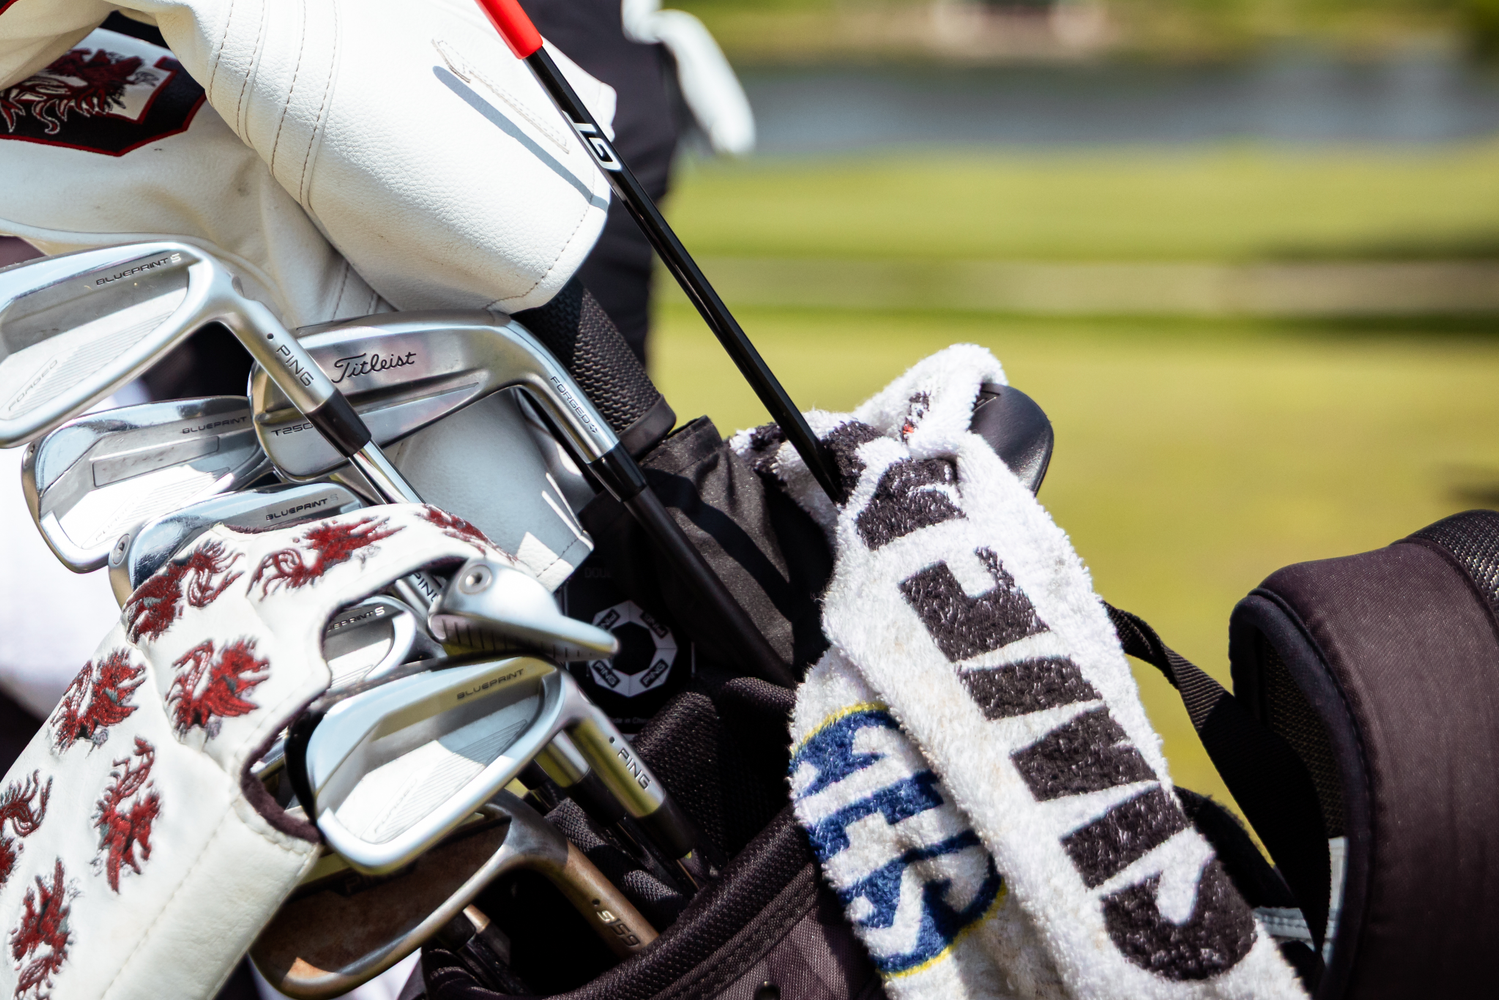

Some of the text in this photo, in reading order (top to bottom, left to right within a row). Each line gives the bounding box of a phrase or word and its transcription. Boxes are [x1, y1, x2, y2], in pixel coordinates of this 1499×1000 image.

[95, 252, 182, 286] BLUEPRINT S
[276, 344, 314, 387] PING
[331, 351, 417, 384] Titleist
[550, 375, 591, 424] FORGED
[182, 416, 247, 434] BLUEPRINT
[265, 498, 328, 521] BLUEPRINT
[327, 611, 373, 633] EPRINT
[457, 668, 524, 700] BLUEPRINT
[617, 747, 650, 790] PING
